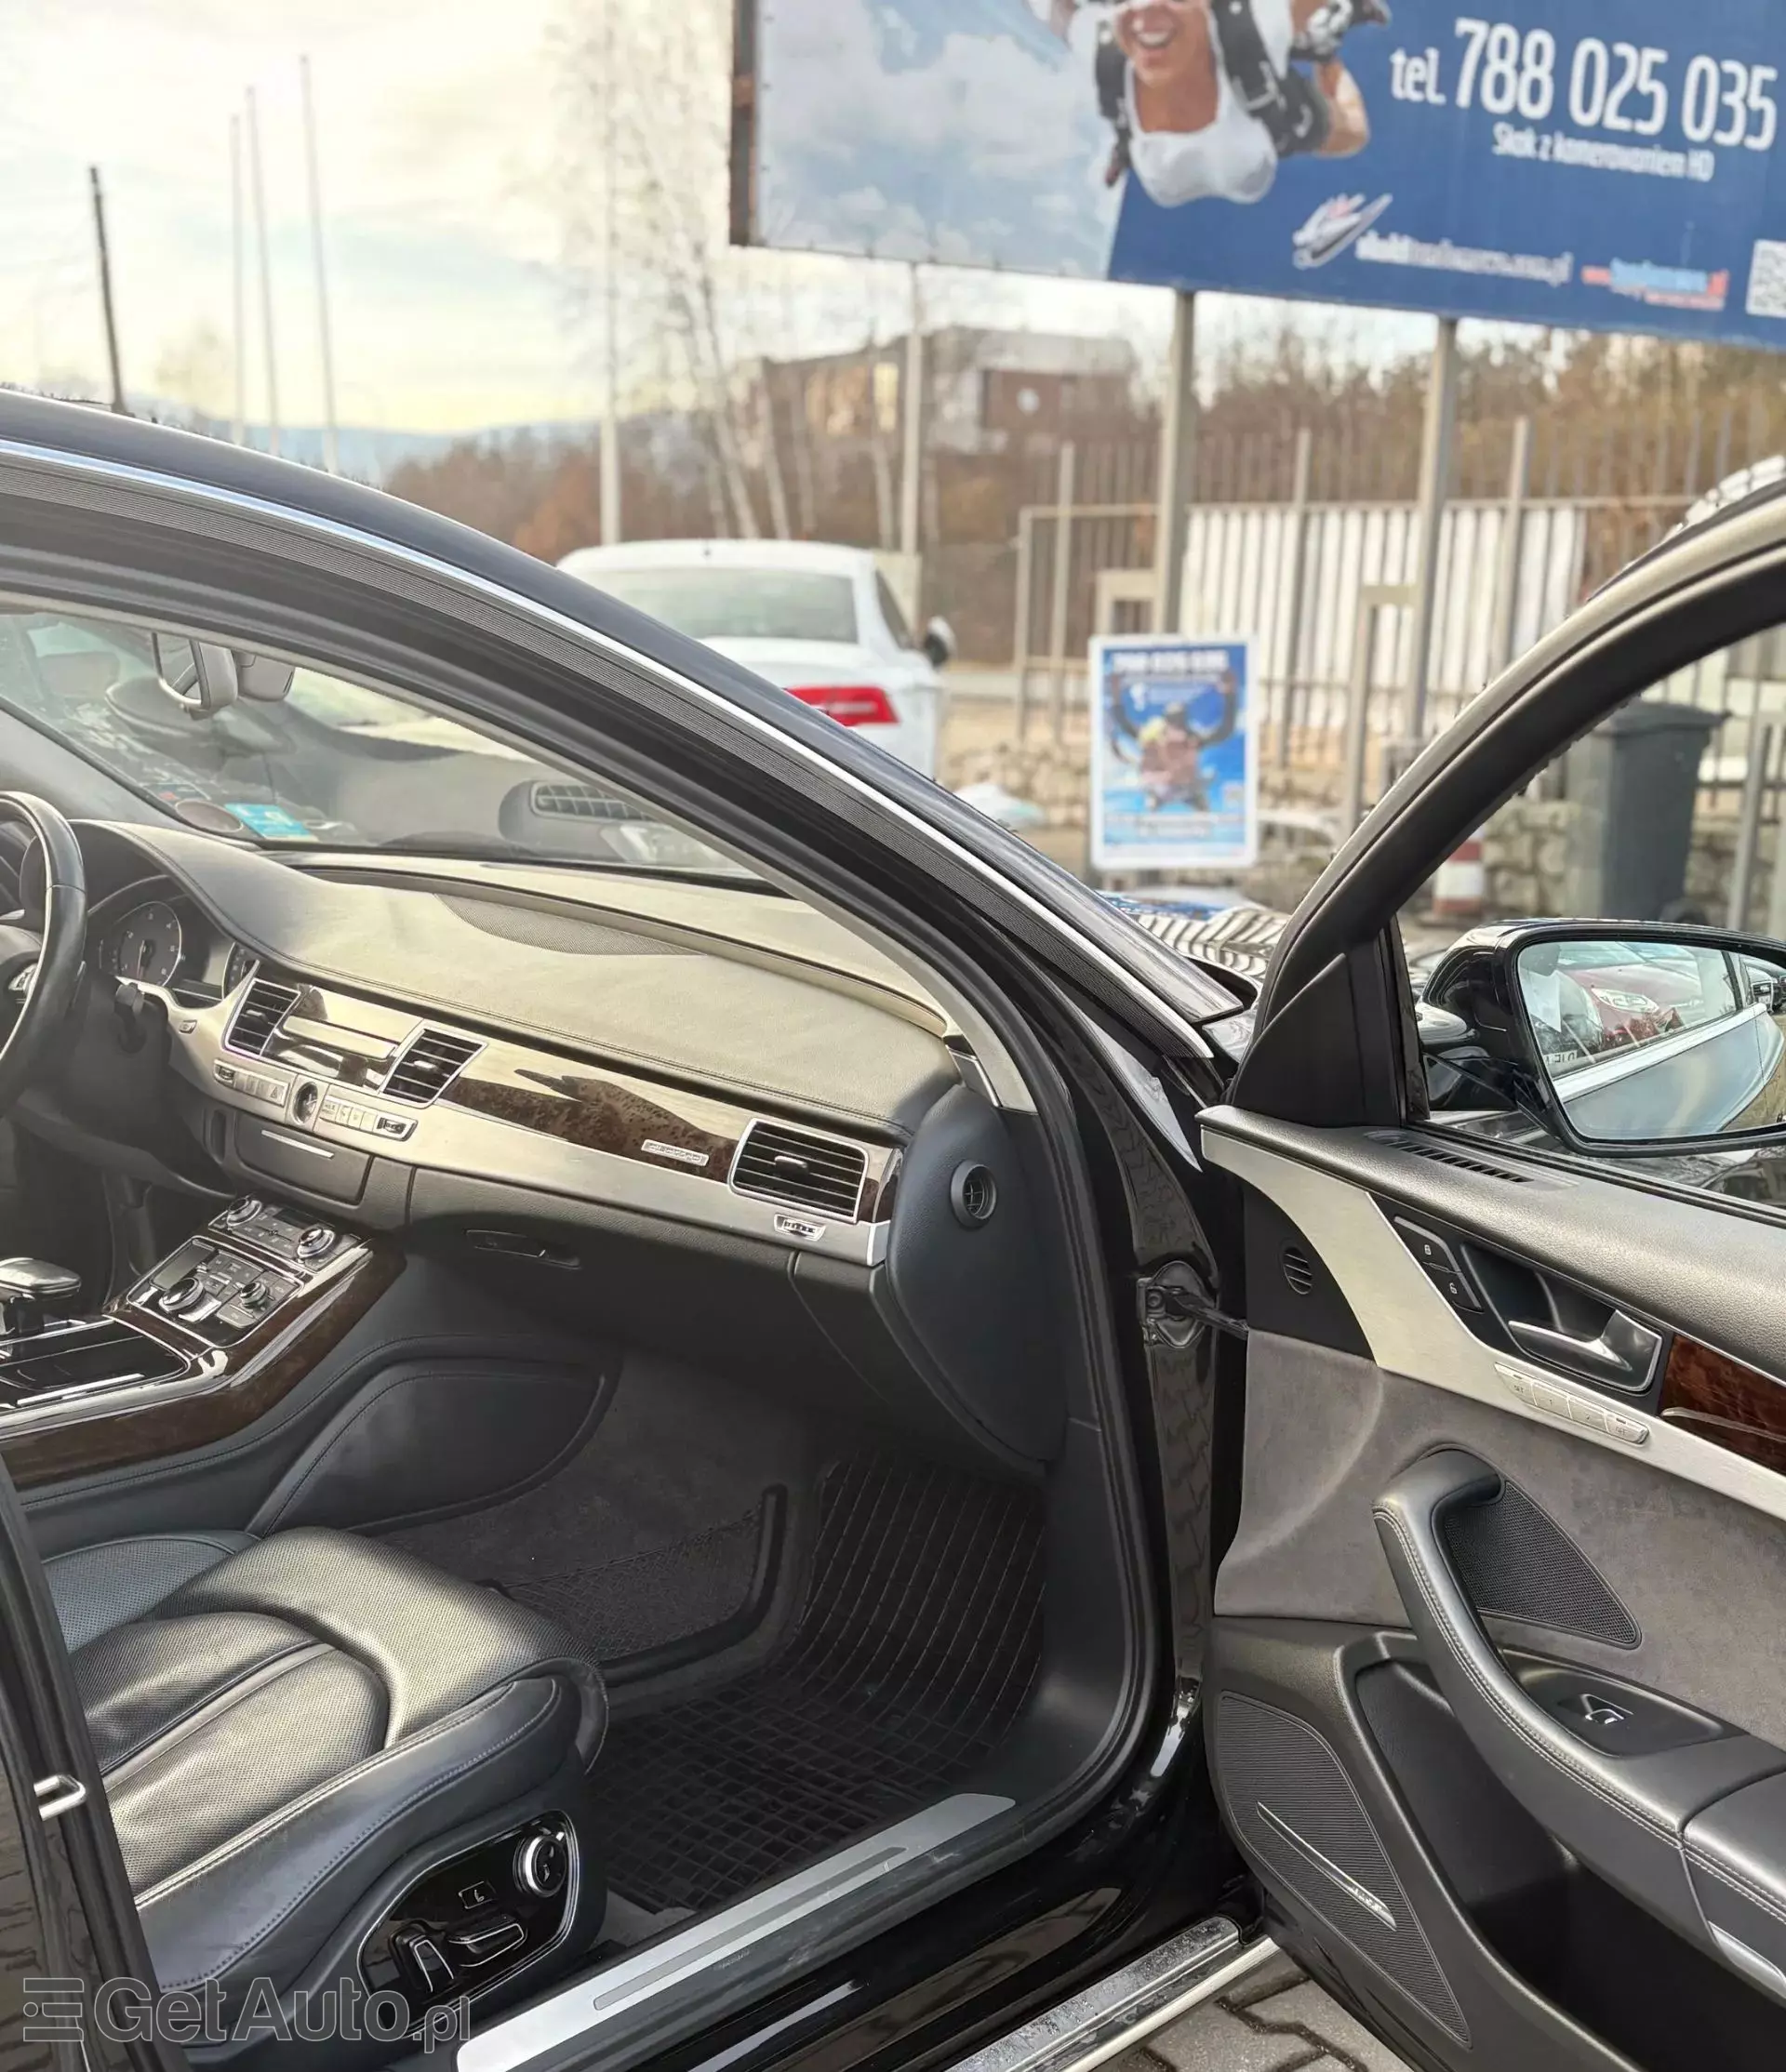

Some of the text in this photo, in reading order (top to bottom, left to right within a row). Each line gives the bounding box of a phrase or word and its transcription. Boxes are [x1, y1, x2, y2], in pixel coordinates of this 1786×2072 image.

[1455, 16, 1556, 120] 788
[1569, 36, 1669, 136] 025
[1681, 54, 1778, 151] 035
